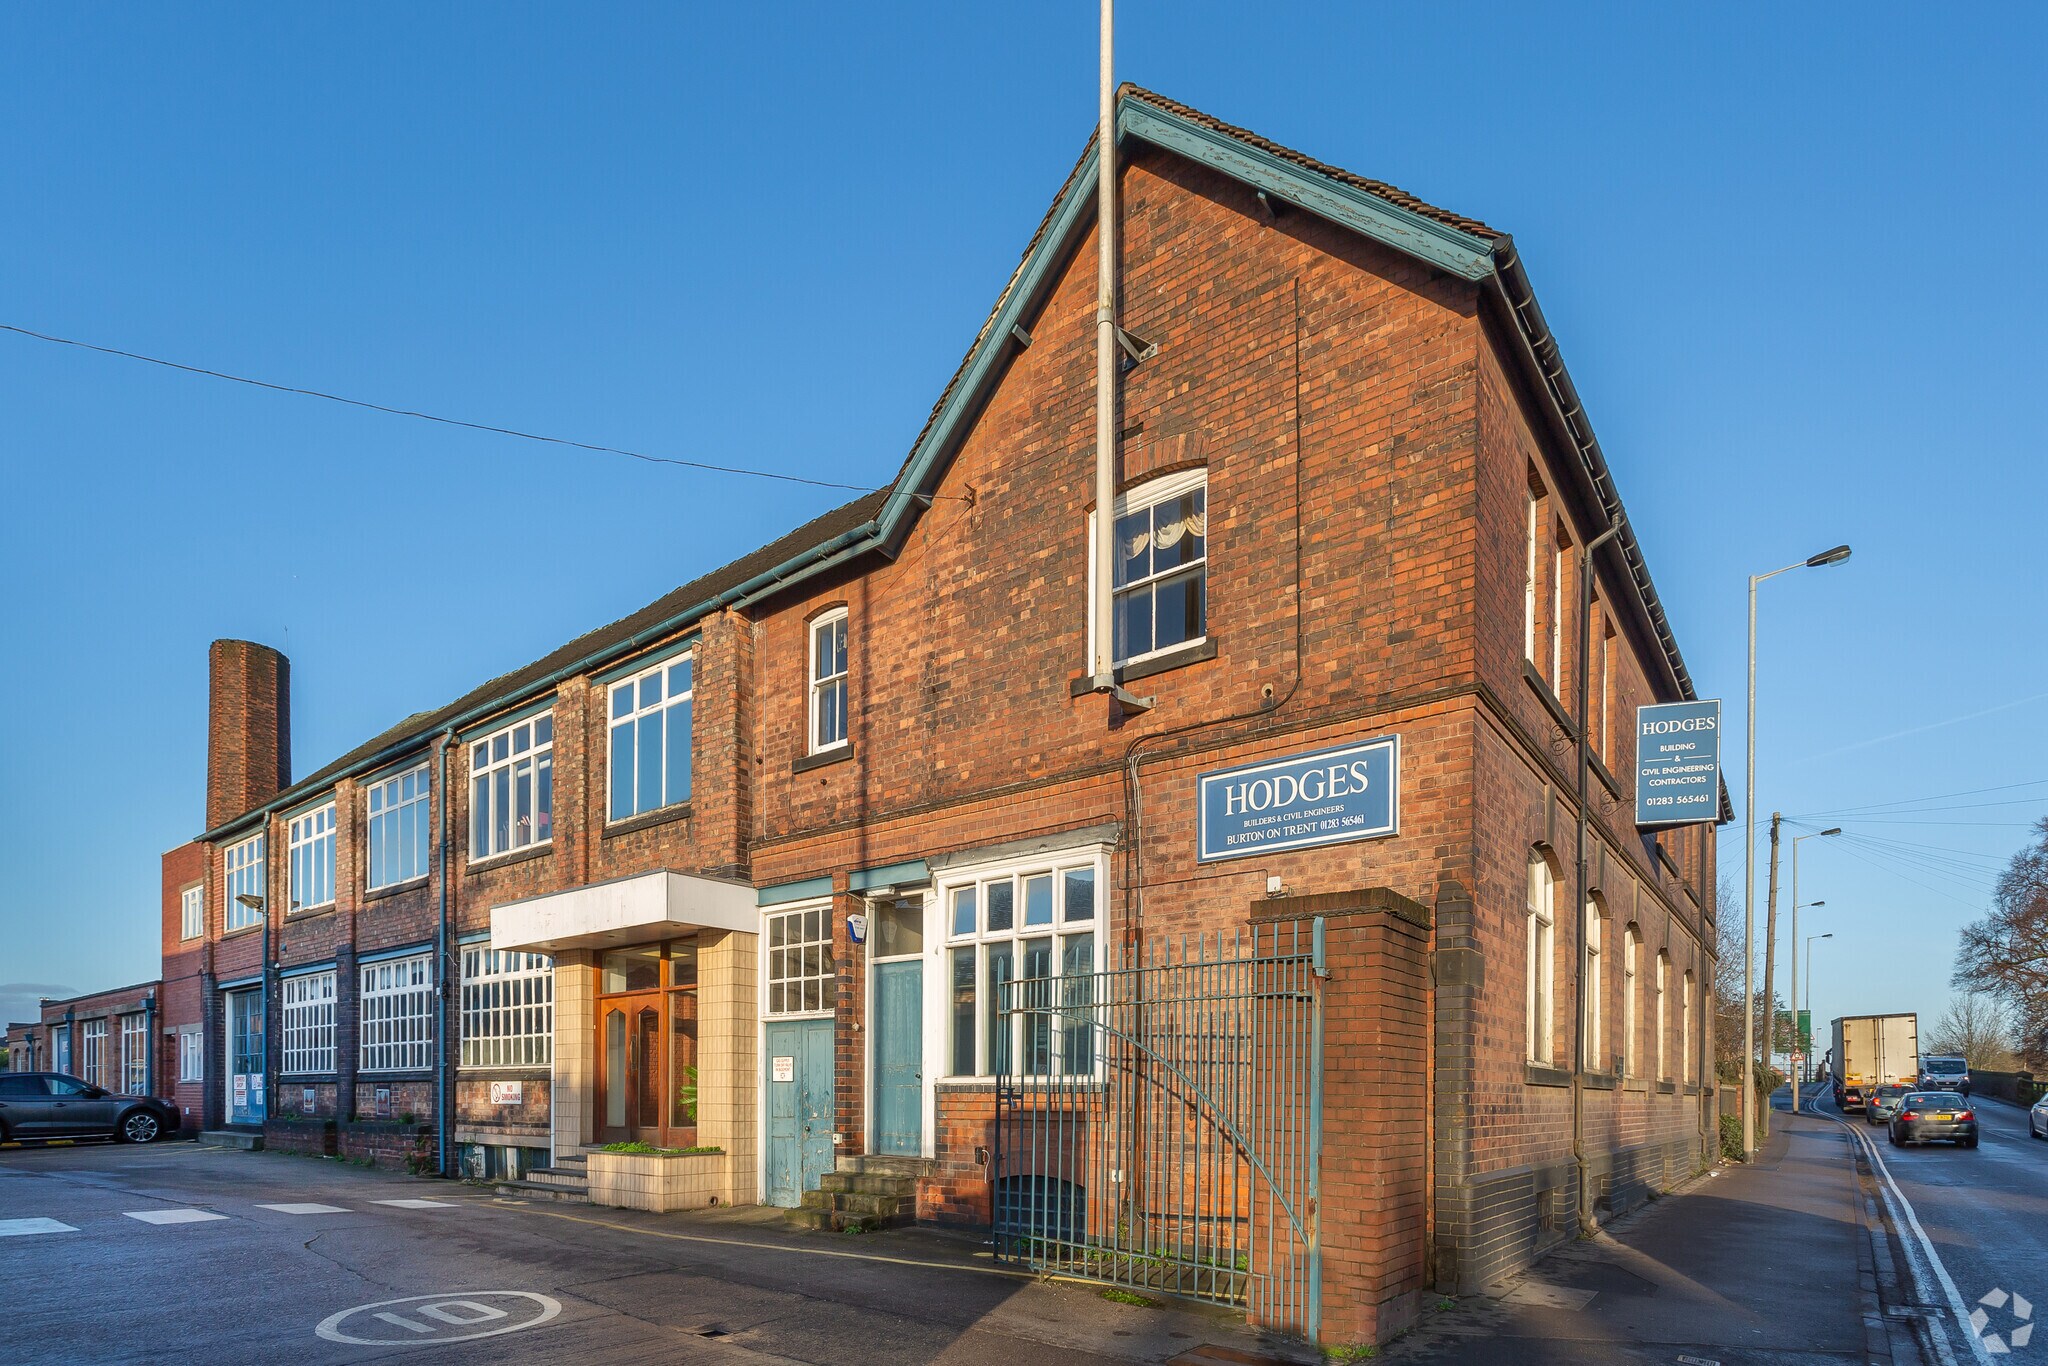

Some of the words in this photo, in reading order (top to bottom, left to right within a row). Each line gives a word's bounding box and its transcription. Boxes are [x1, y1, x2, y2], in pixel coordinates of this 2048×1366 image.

[1642, 717, 1716, 735] HODGES
[1660, 743, 1696, 752] BUILDING
[1641, 768, 1660, 776] CIVIL
[1662, 764, 1715, 775] ENGINEERING
[1224, 760, 1369, 816] HODGES
[1649, 776, 1707, 787] CONTRACTORS
[1646, 796, 1673, 806] 01283
[1676, 794, 1709, 804] 565461
[1243, 815, 1276, 828] BUILDERS
[1277, 814, 1283, 822] &
[1283, 811, 1303, 821] CIVIL
[1304, 804, 1345, 818] ENGINEERS
[1227, 830, 1265, 845] BURTON
[1266, 828, 1281, 838] ON
[1283, 821, 1318, 836] TRENT
[1320, 819, 1340, 830] 01283
[1341, 814, 1366, 826] 565461
[371, 1300, 509, 1333] 10
